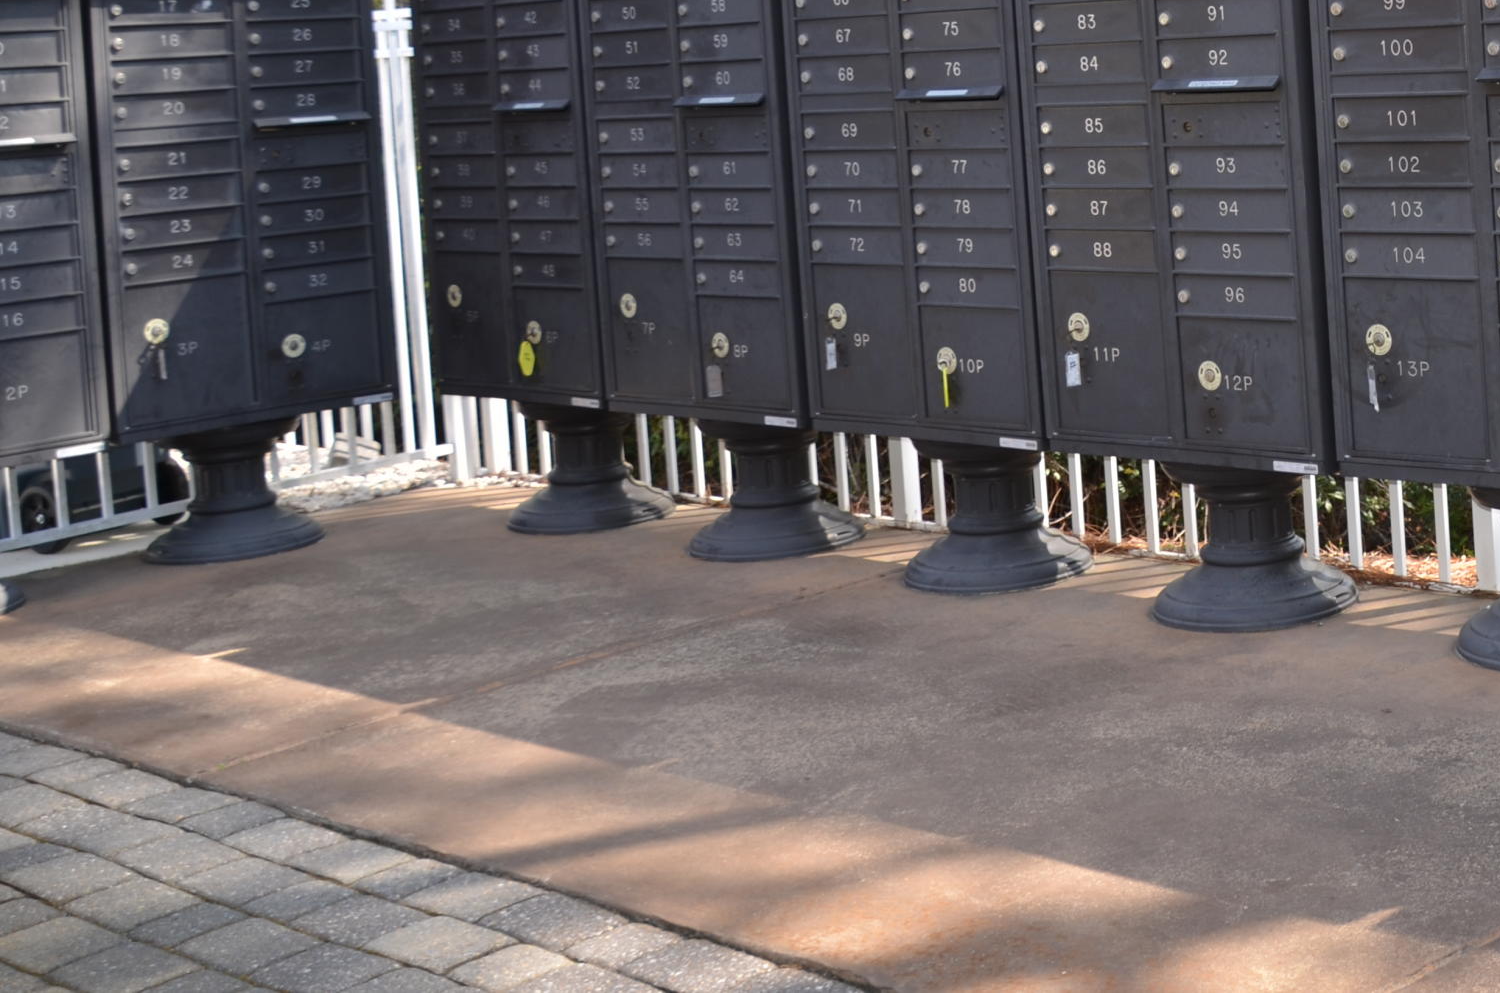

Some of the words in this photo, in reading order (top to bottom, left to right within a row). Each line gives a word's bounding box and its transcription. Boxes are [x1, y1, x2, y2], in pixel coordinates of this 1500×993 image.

[159, 0, 177, 12] 17
[622, 6, 636, 20] 50
[1207, 6, 1224, 21] 91
[943, 21, 959, 36] 75
[1078, 14, 1096, 30] 83
[161, 34, 180, 47] 18
[293, 28, 312, 41] 26
[713, 34, 728, 48] 59
[836, 28, 851, 43] 67
[626, 41, 637, 54] 51
[1381, 39, 1413, 56] 100
[1080, 56, 1098, 71] 84
[1209, 49, 1228, 65] 92
[163, 67, 182, 80] 19
[294, 60, 313, 73] 27
[945, 62, 961, 76] 76
[715, 71, 730, 85] 60
[838, 67, 854, 81] 68
[627, 76, 640, 90] 52
[162, 101, 184, 115] 20
[1387, 110, 1416, 126] 101
[842, 123, 857, 137] 69
[1085, 118, 1103, 133] 85
[630, 128, 644, 141] 53
[167, 152, 186, 165] 21
[1216, 158, 1236, 173] 93
[1389, 156, 1420, 173] 102
[633, 163, 647, 176] 54
[723, 161, 736, 175] 61
[844, 162, 860, 176] 70
[952, 159, 967, 173] 77
[1088, 159, 1106, 174] 86
[302, 176, 321, 189] 29
[168, 186, 188, 200] 22
[635, 198, 649, 211] 55
[725, 198, 740, 211] 62
[848, 199, 861, 212] 71
[954, 199, 970, 214] 78
[1090, 200, 1108, 215] 87
[1219, 201, 1238, 216] 94
[1391, 201, 1423, 217] 103
[305, 208, 324, 222] 30
[171, 219, 191, 233] 23
[638, 233, 651, 246] 56
[727, 233, 741, 246] 63
[850, 237, 864, 252] 72
[957, 238, 973, 253] 79
[308, 240, 324, 254] 31
[1094, 242, 1112, 257] 88
[1222, 243, 1241, 259] 95
[172, 254, 193, 268] 24
[1393, 247, 1425, 263] 104
[0, 276, 21, 290] 15
[309, 273, 327, 287] 32
[729, 270, 744, 283] 64
[959, 278, 976, 293] 80
[1225, 287, 1244, 303] 96
[3, 312, 24, 326] 16
[641, 322, 655, 334] 7P
[854, 333, 870, 347] 9P
[178, 341, 198, 356] 3P
[734, 344, 748, 358] 8P
[1094, 347, 1120, 362] 11P
[959, 359, 984, 373] 10P
[1397, 361, 1429, 377] 13P
[1224, 375, 1252, 391] 12P
[6, 385, 28, 401] 2P
